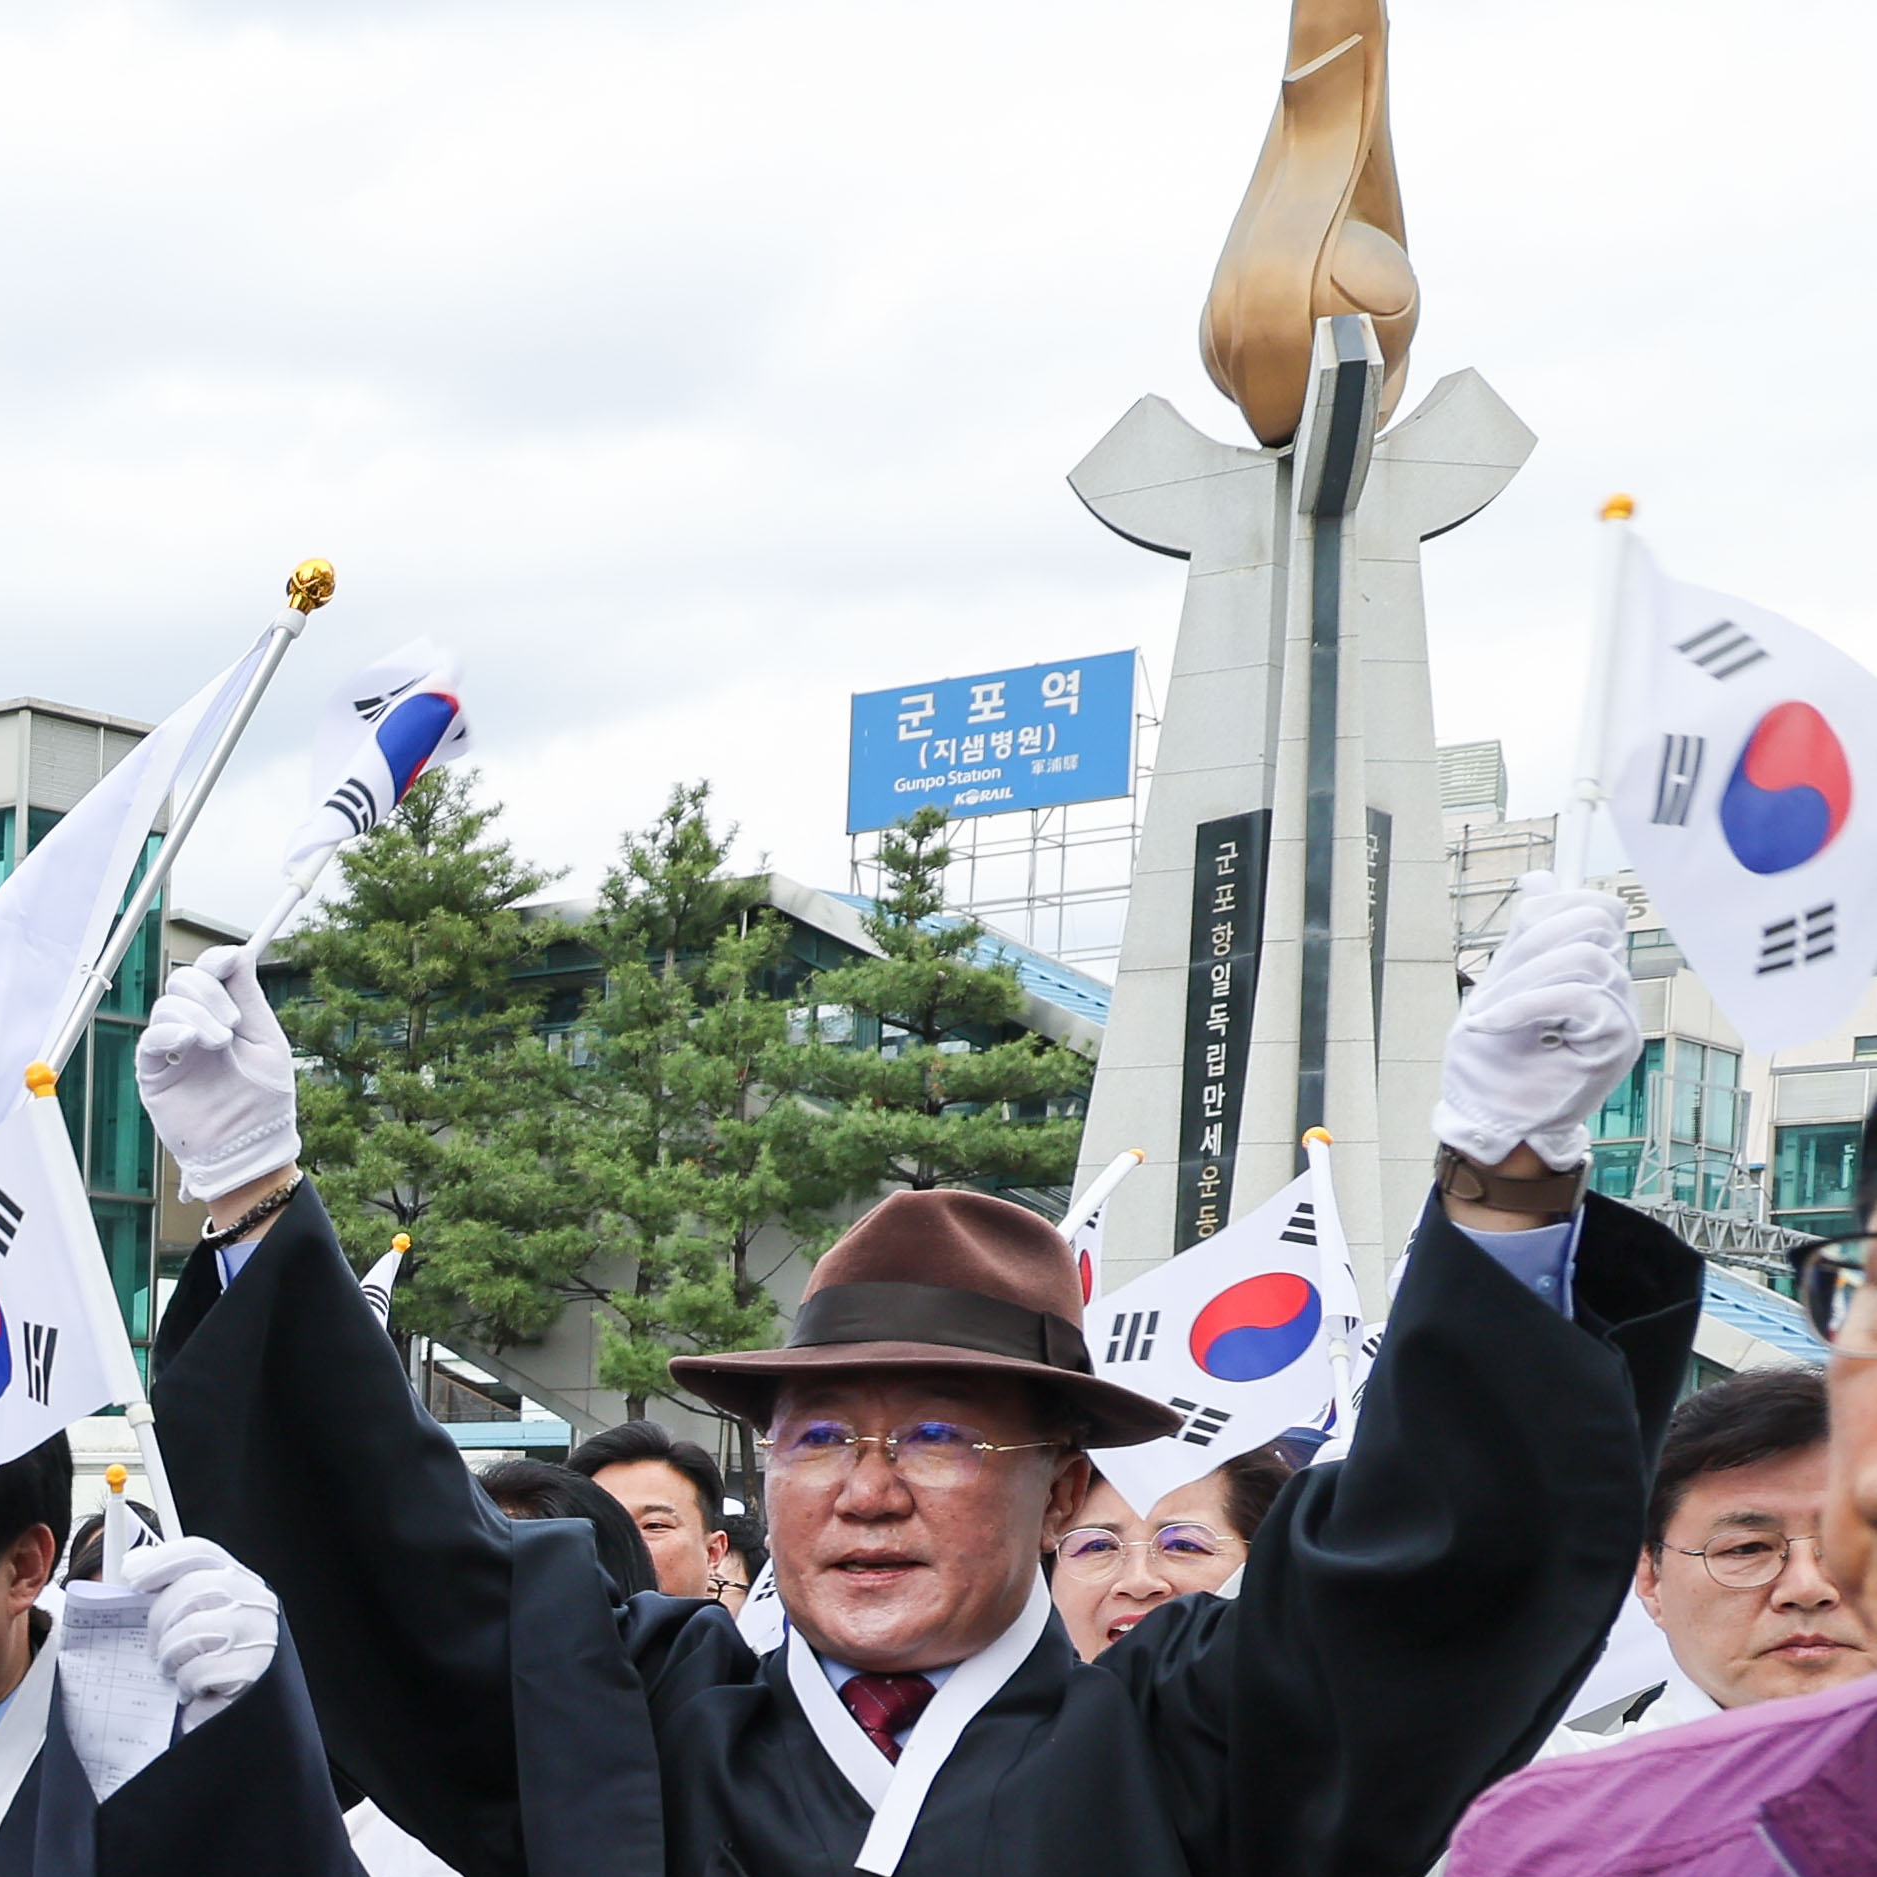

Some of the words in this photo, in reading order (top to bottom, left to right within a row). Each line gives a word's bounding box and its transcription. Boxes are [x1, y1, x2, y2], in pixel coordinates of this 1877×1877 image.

[897, 669, 1082, 742] 군포역
[918, 722, 1057, 770] (지샘병원)
[894, 776, 945, 793] Gunpo
[947, 767, 1002, 786] Station
[954, 787, 1014, 806] KORAIL
[1195, 840, 1239, 1239] 군포항일독립만세운동
